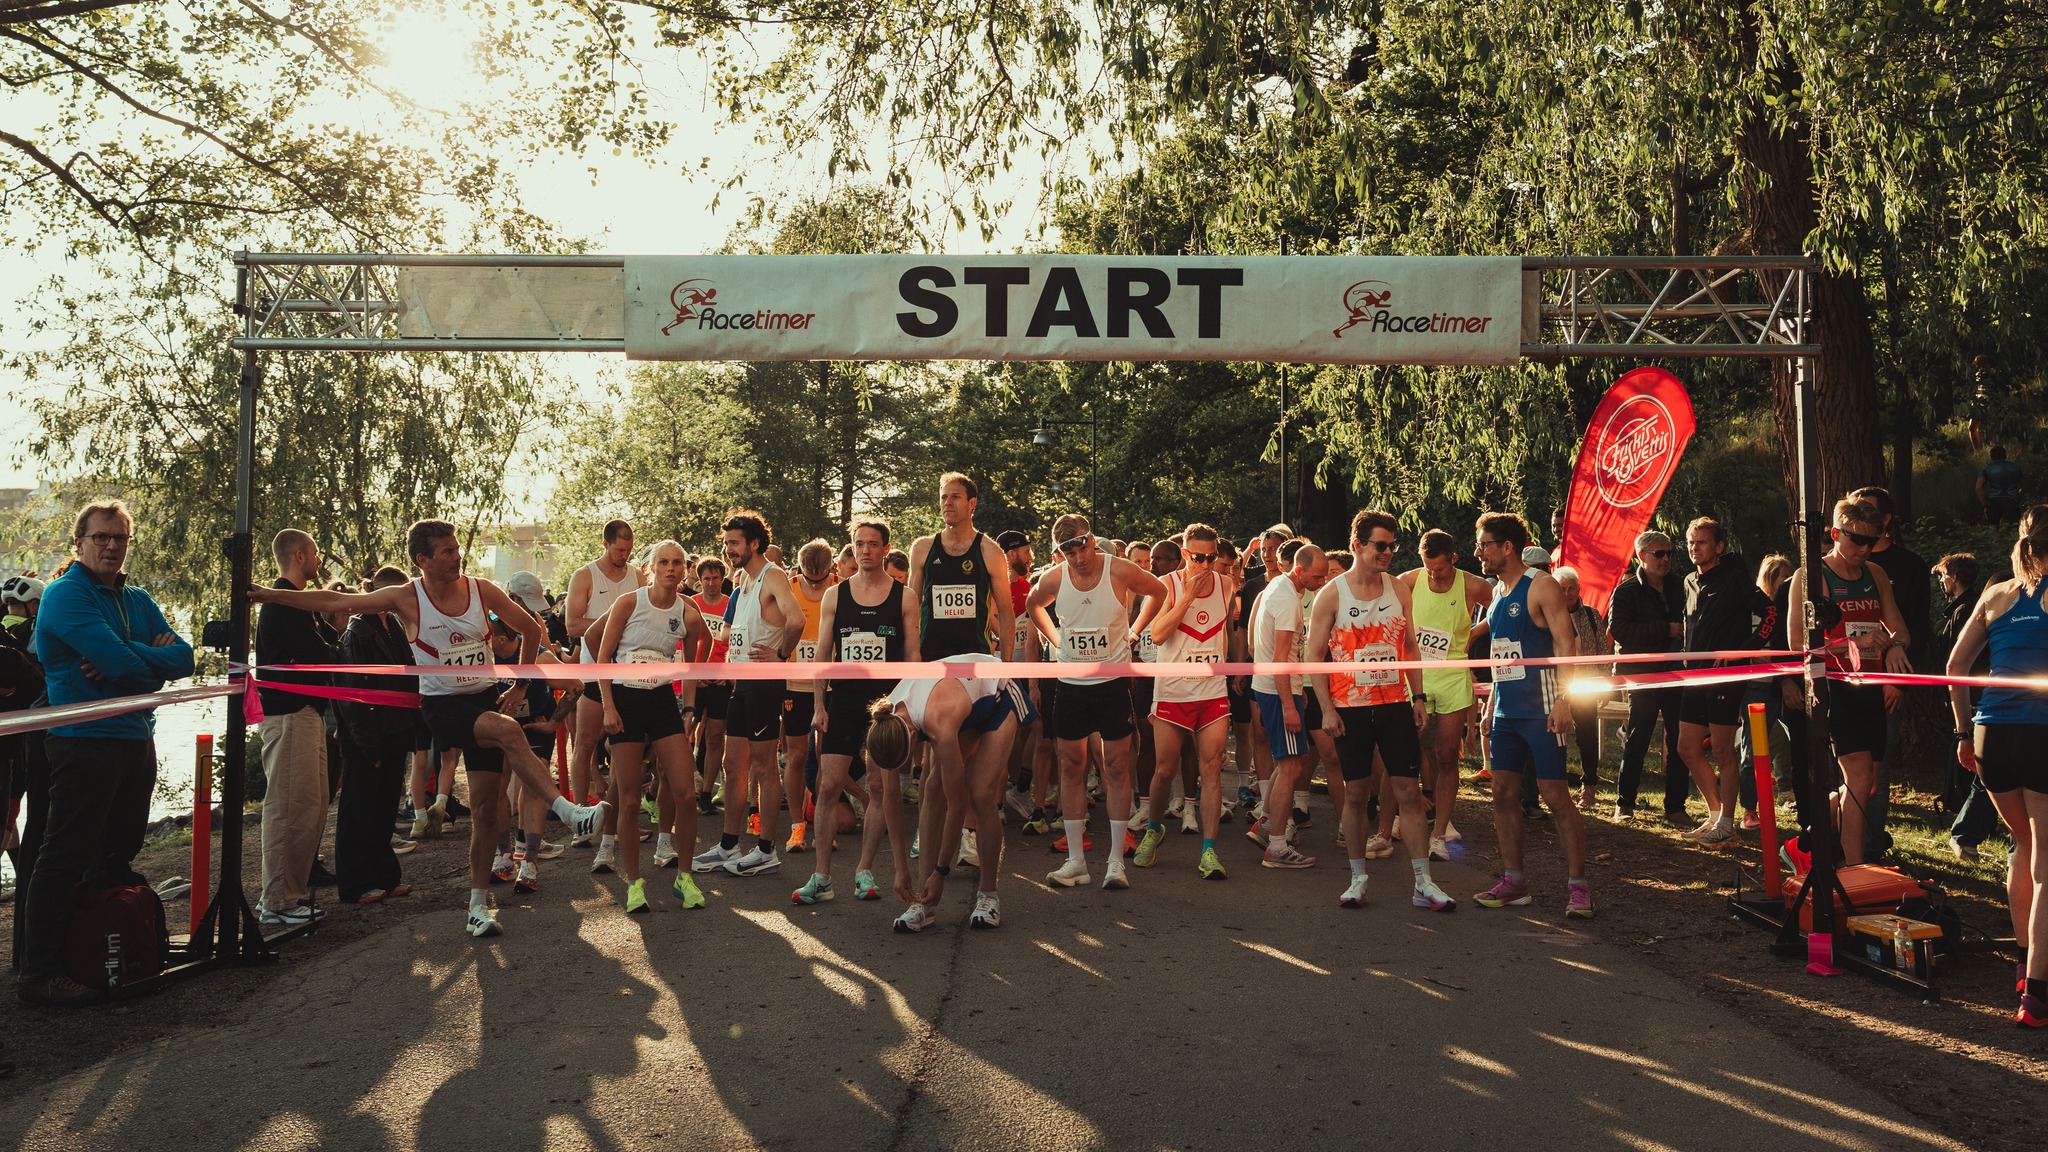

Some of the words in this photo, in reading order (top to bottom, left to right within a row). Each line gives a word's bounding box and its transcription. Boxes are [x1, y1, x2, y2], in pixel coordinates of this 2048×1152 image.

[896, 265, 1243, 338] START
[699, 307, 815, 330] Racetimer
[1372, 310, 1492, 333] Racetimer
[935, 593, 974, 607] 1086
[1838, 600, 1880, 612] KENYA
[1068, 634, 1108, 649] 1514
[1416, 632, 1449, 652] 1622
[799, 646, 815, 659] 13
[844, 646, 883, 661] 1352
[1370, 672, 1389, 680] HELIO
